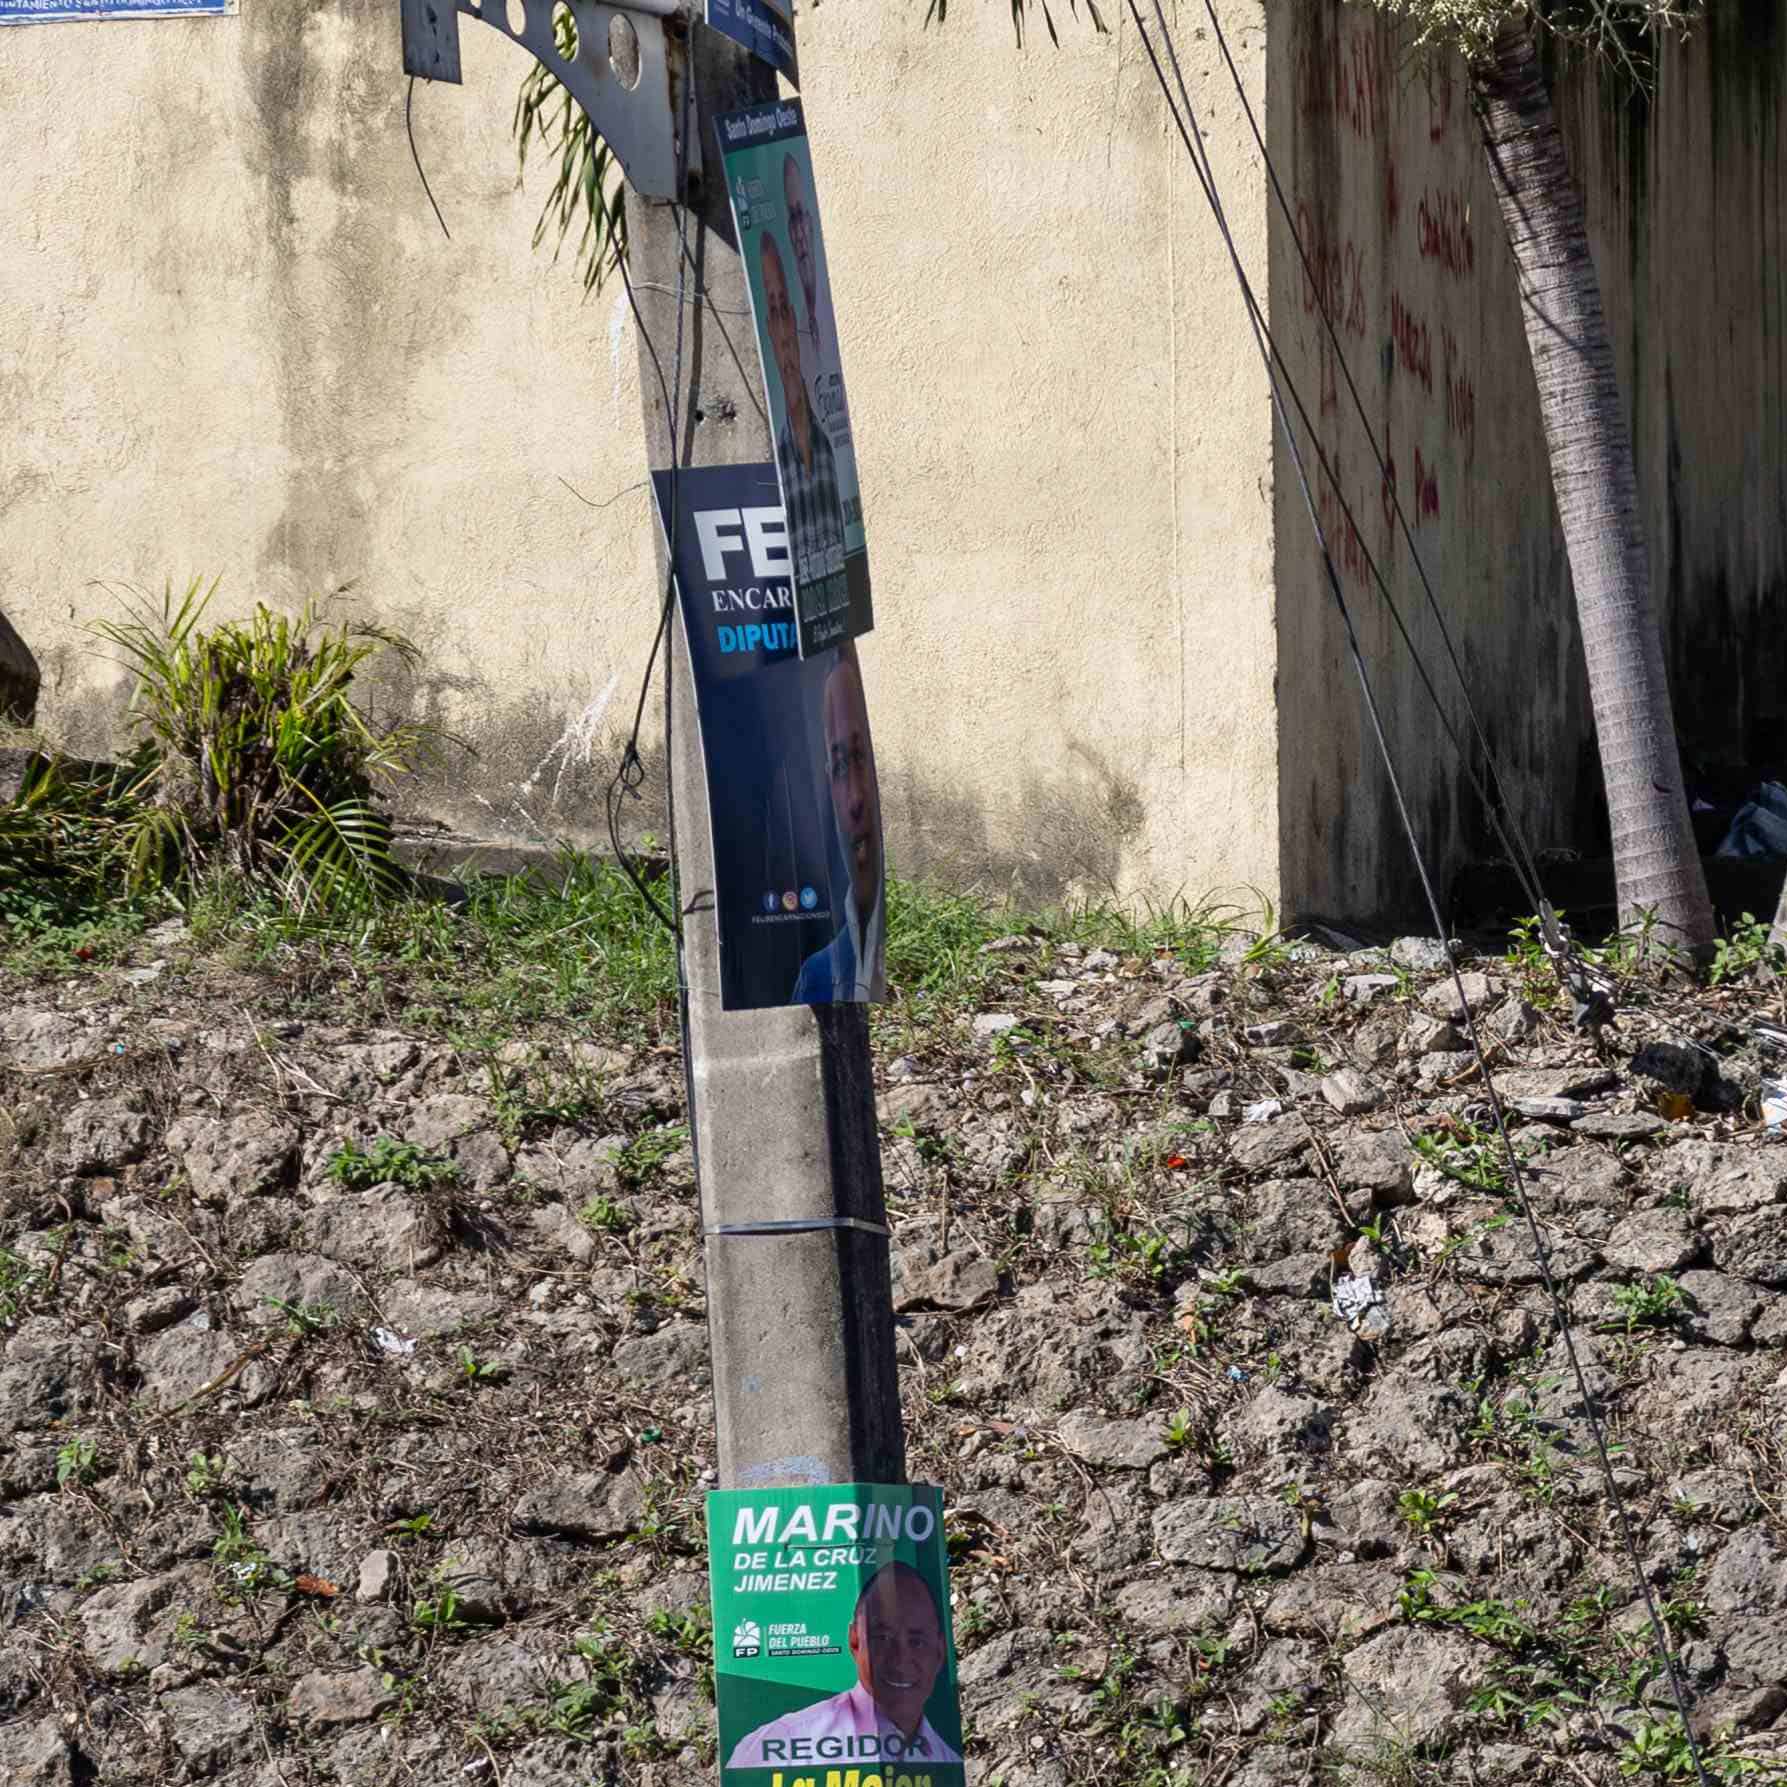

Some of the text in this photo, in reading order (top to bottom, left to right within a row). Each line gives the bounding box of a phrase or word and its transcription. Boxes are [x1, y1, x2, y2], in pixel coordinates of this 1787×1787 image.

[745, 112, 776, 137] Domingo
[732, 1503, 935, 1546] MARINO
[733, 1547, 877, 1571] DE LA CRUZ
[733, 1571, 838, 1594] JIMENEZ
[768, 1623, 807, 1636] FUERZA
[769, 1634, 830, 1648] DEL PUEBLO
[735, 1647, 759, 1657] FP
[762, 1734, 929, 1761] REGIDOR
